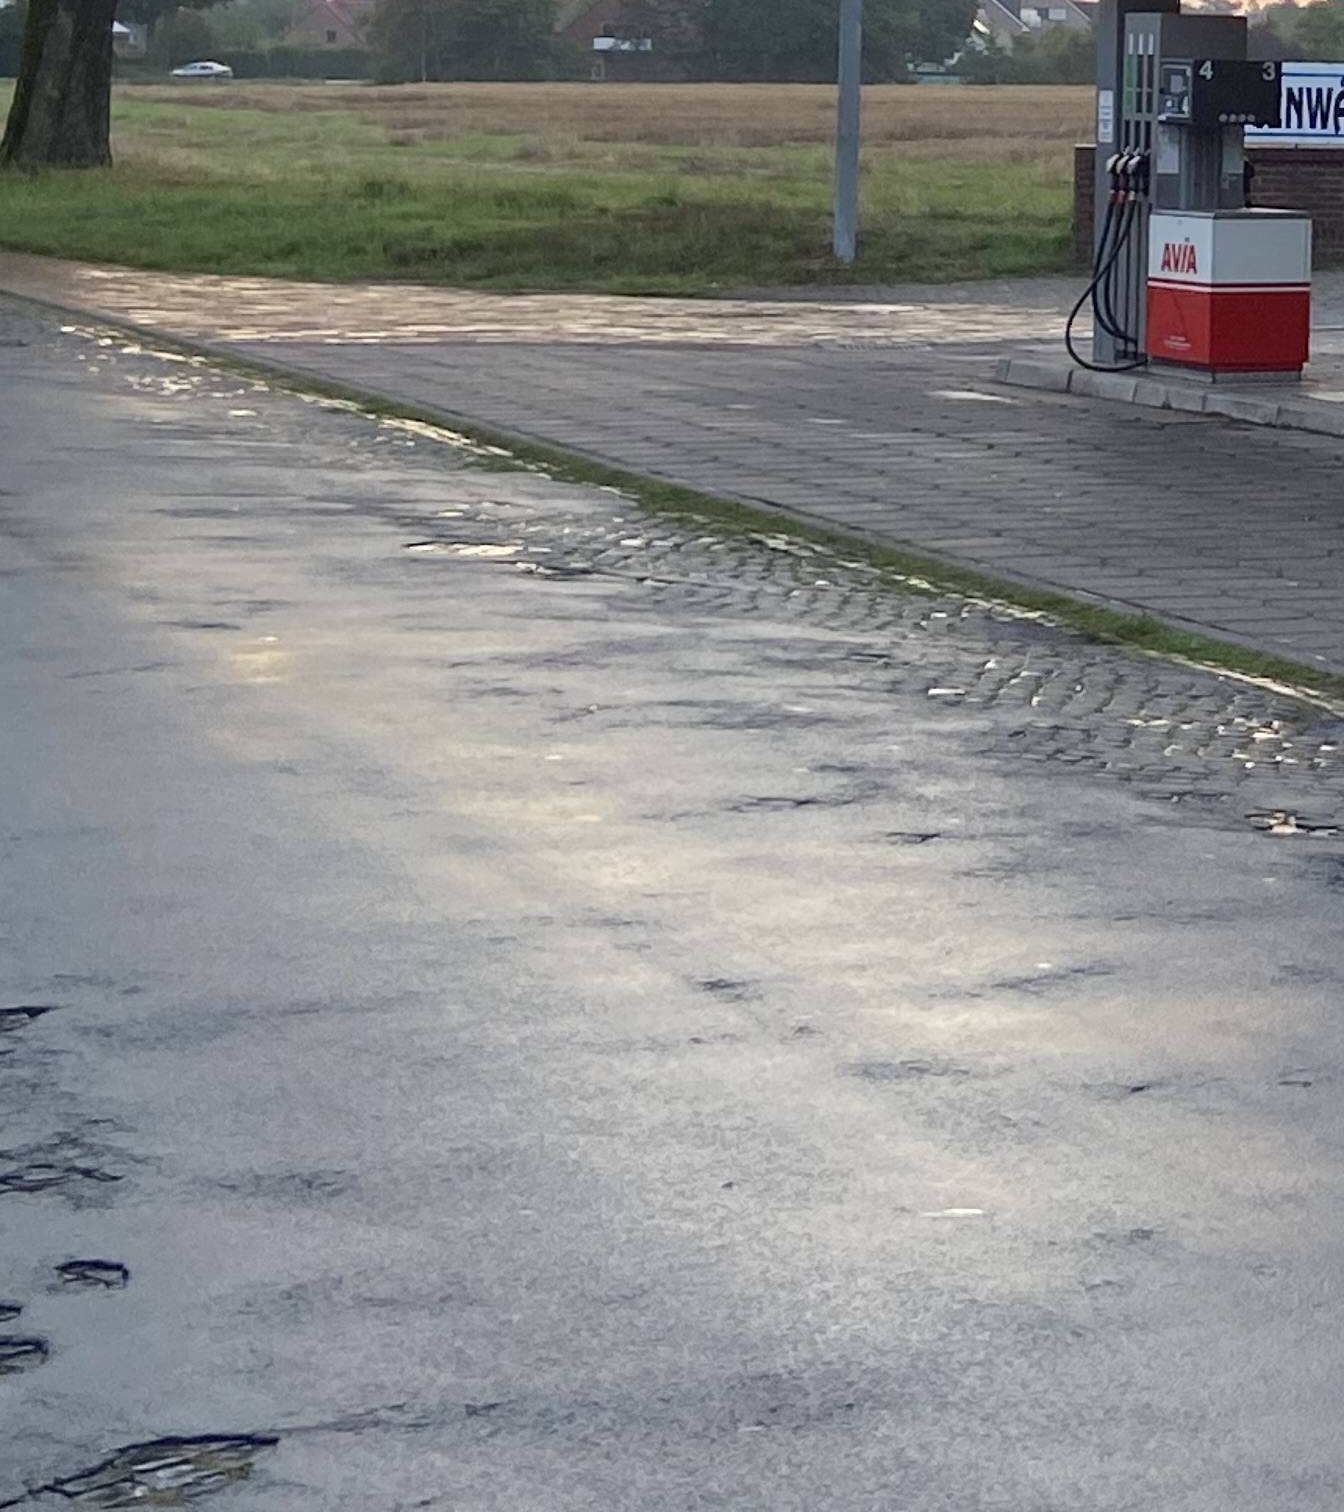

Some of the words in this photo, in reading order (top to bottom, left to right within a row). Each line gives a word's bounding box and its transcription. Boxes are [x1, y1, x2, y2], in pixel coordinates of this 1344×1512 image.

[1199, 60, 1213, 80] 4
[1262, 62, 1276, 81] 3
[1160, 237, 1198, 275] AVIA
